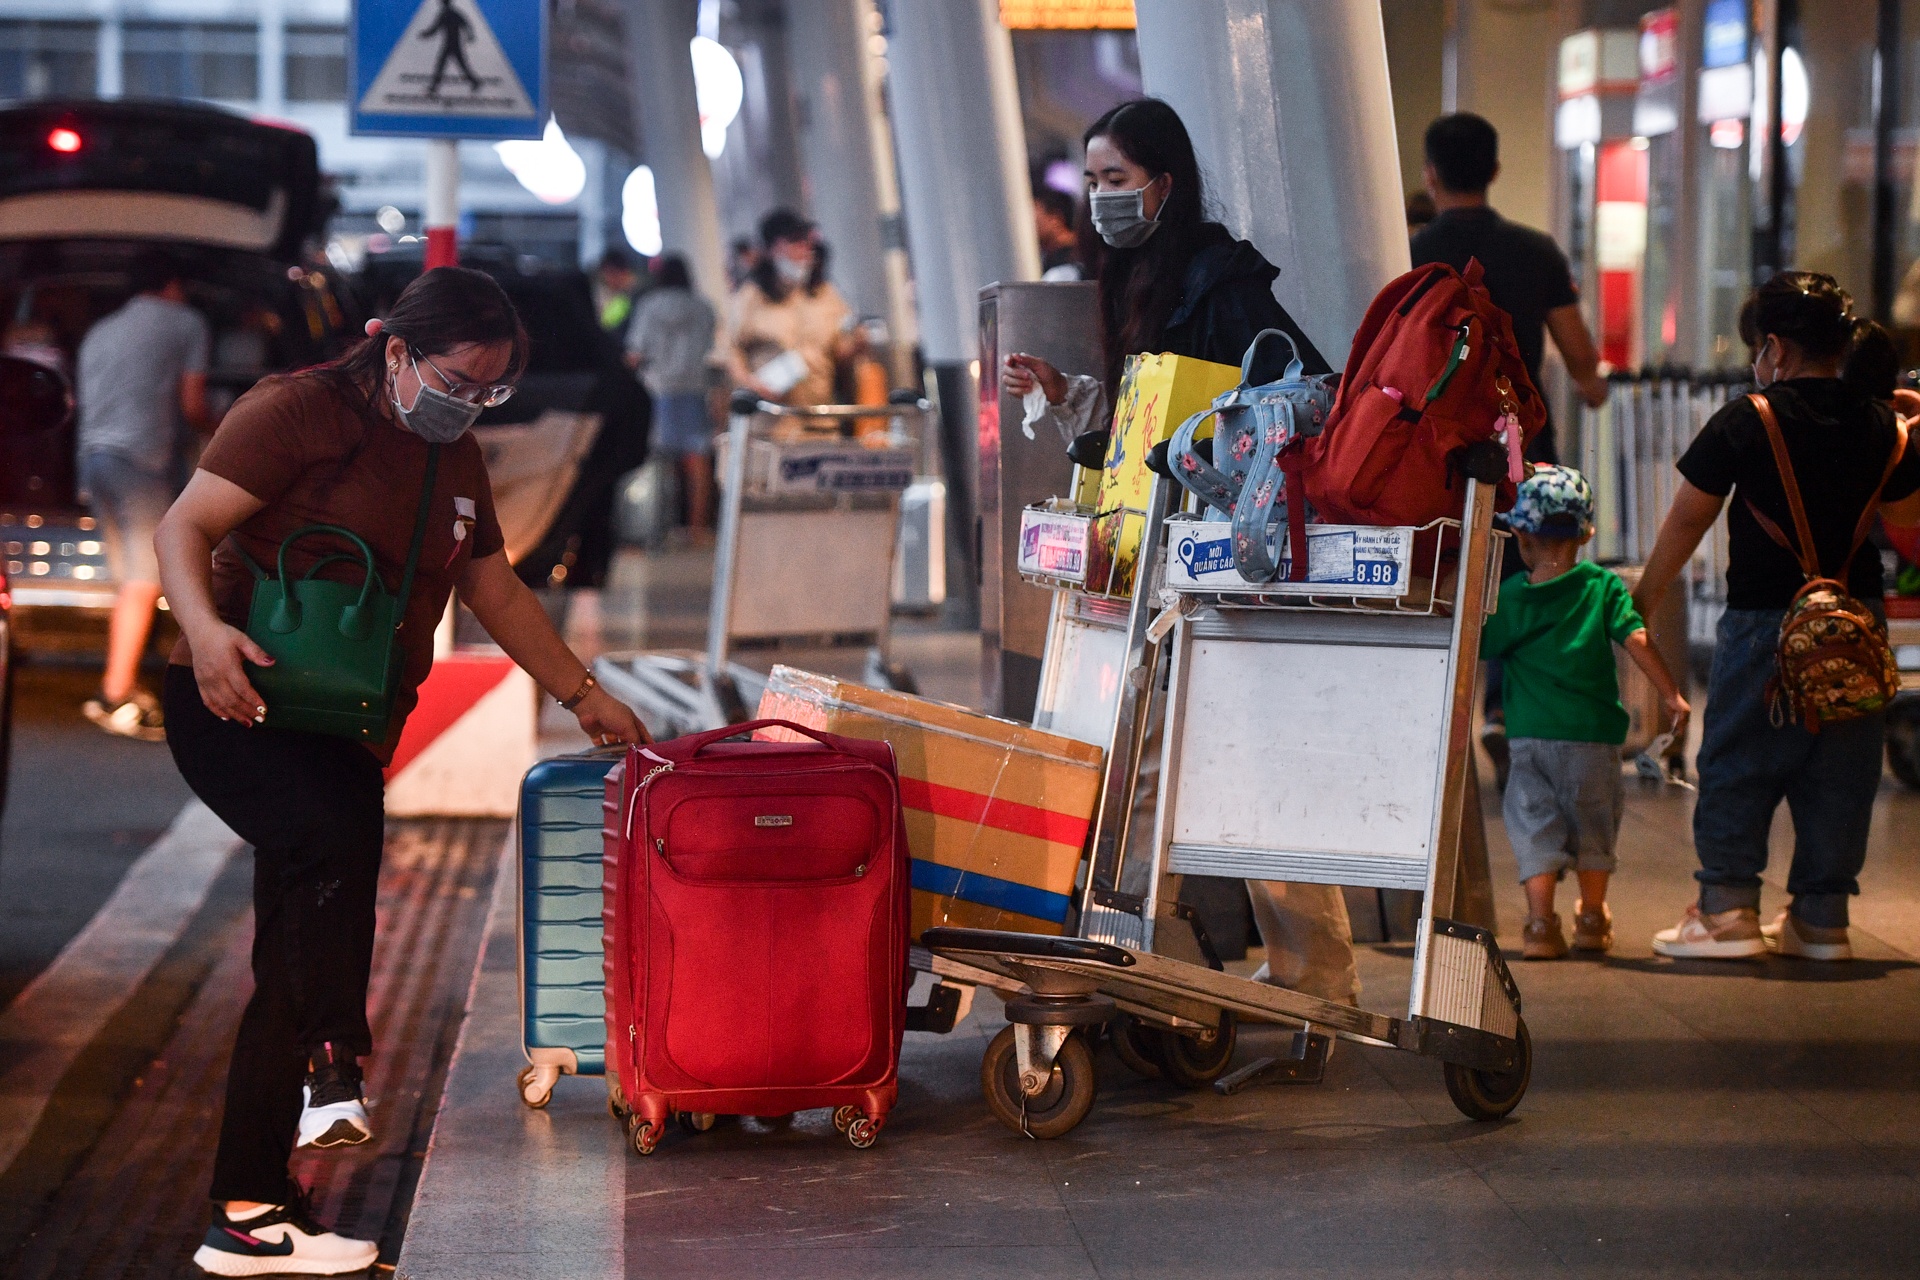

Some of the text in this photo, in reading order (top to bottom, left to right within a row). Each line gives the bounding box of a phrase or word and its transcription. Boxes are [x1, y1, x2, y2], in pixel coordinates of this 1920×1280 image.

[1208, 545, 1222, 558] MỜI
[1194, 555, 1234, 572] QUẢNG CÁO
